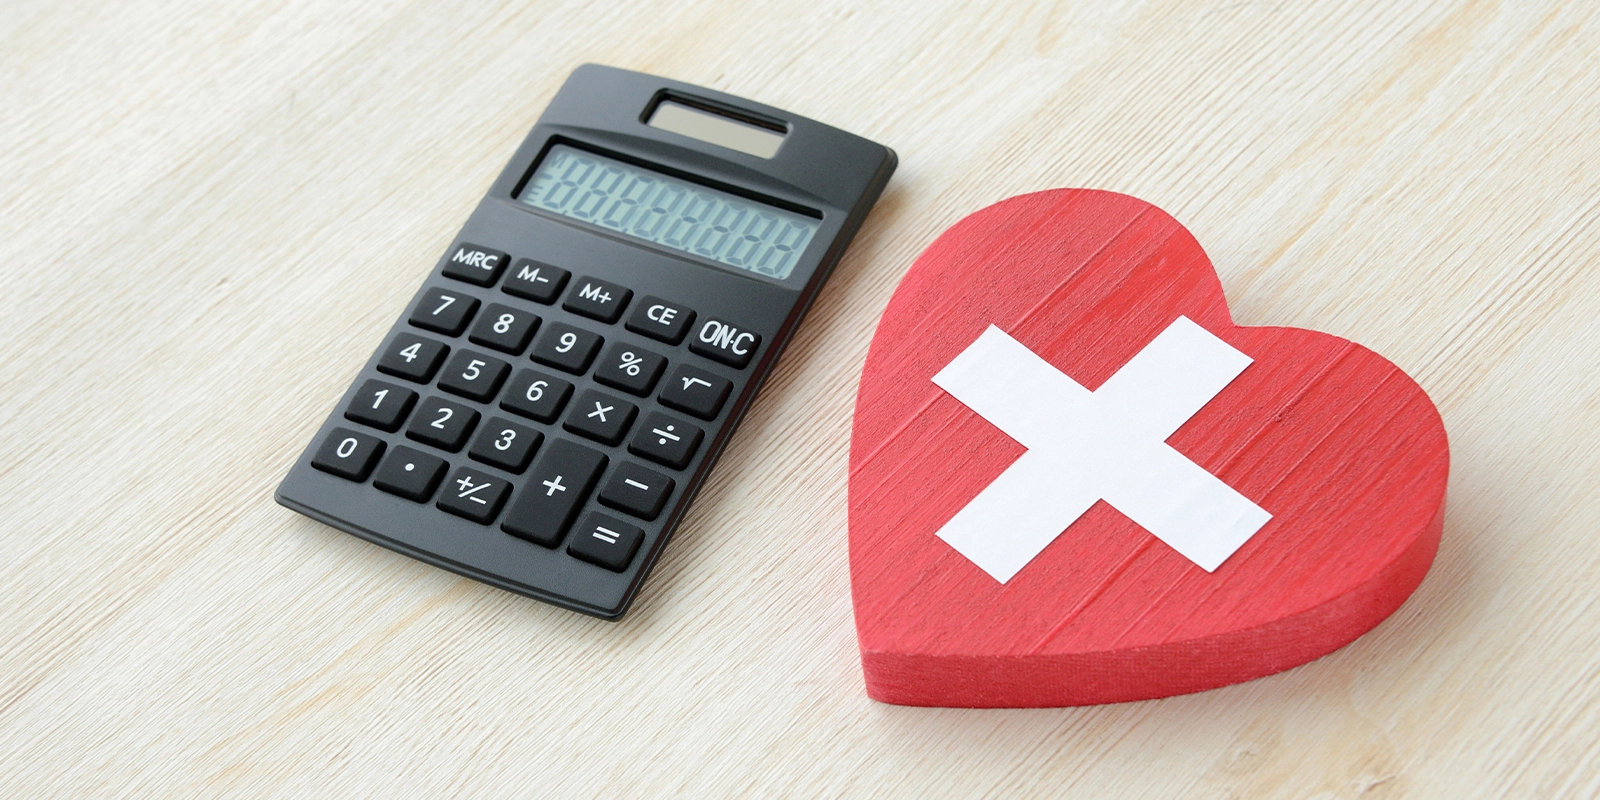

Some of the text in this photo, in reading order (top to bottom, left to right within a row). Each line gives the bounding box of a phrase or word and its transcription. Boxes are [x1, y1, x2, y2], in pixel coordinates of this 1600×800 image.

[453, 247, 498, 271] MRC
[579, 282, 612, 304] M+
[646, 304, 678, 326] CE
[432, 294, 456, 315] 7
[493, 313, 515, 334] 8
[555, 332, 577, 353] 9
[619, 351, 643, 377] %
[398, 342, 422, 363] 4
[461, 359, 486, 381] 5
[526, 380, 548, 402] 6
[336, 437, 358, 459] 0
[372, 388, 390, 410] 1
[430, 407, 454, 430] 2
[494, 428, 517, 451] 3
